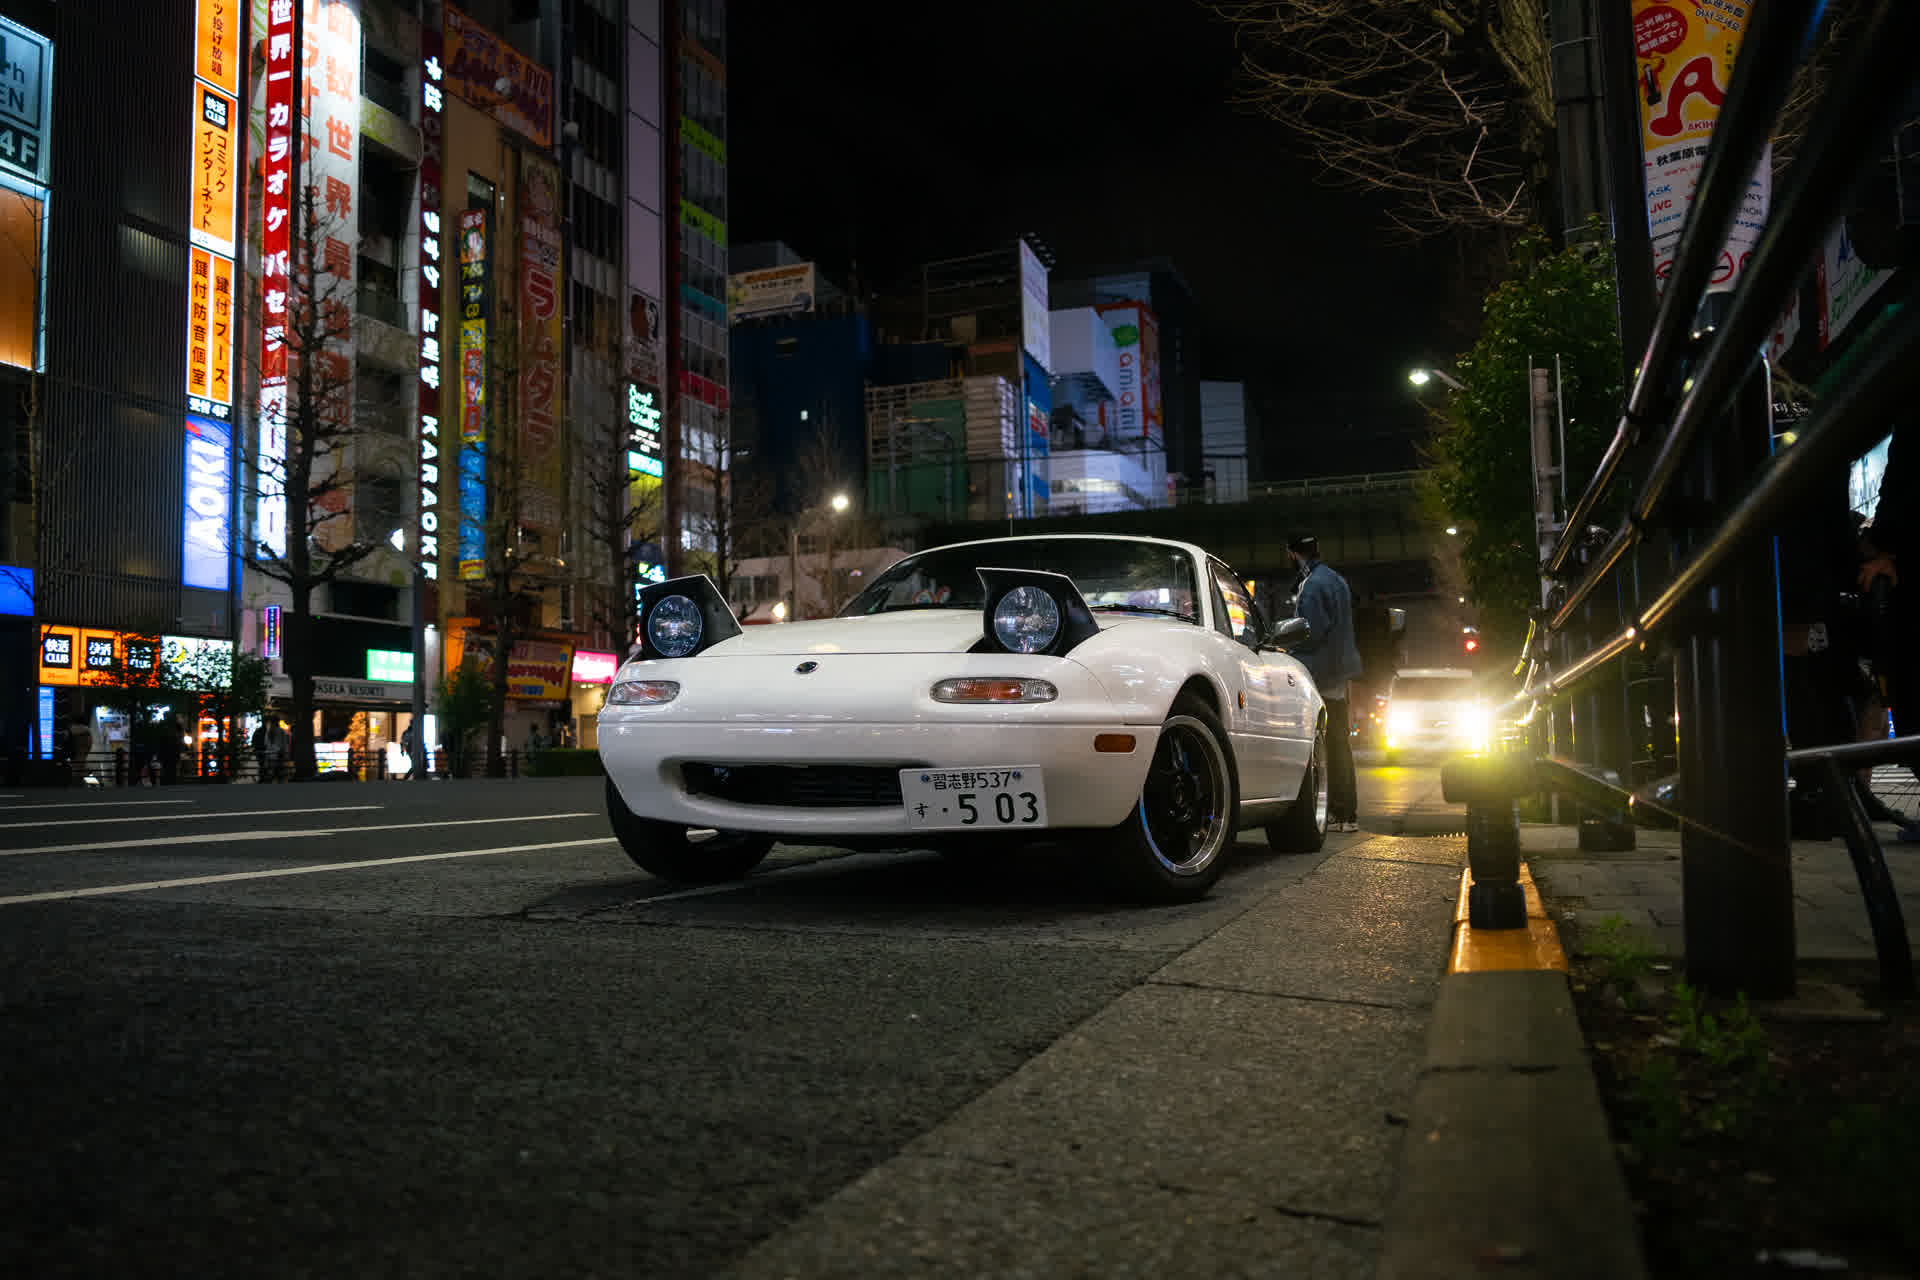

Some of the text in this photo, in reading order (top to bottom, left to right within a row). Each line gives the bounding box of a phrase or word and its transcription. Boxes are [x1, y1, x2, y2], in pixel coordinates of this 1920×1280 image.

[216, 135, 228, 192] コミック
[1657, 145, 1711, 167] 秋葉原電
[201, 131, 214, 228] インターネット
[1650, 199, 1672, 214] JVC
[211, 402, 229, 417] 4F
[188, 439, 225, 554] AOKI
[421, 414, 438, 579] KARAOKE
[45, 651, 69, 664] CLUB
[914, 803, 928, 818] す
